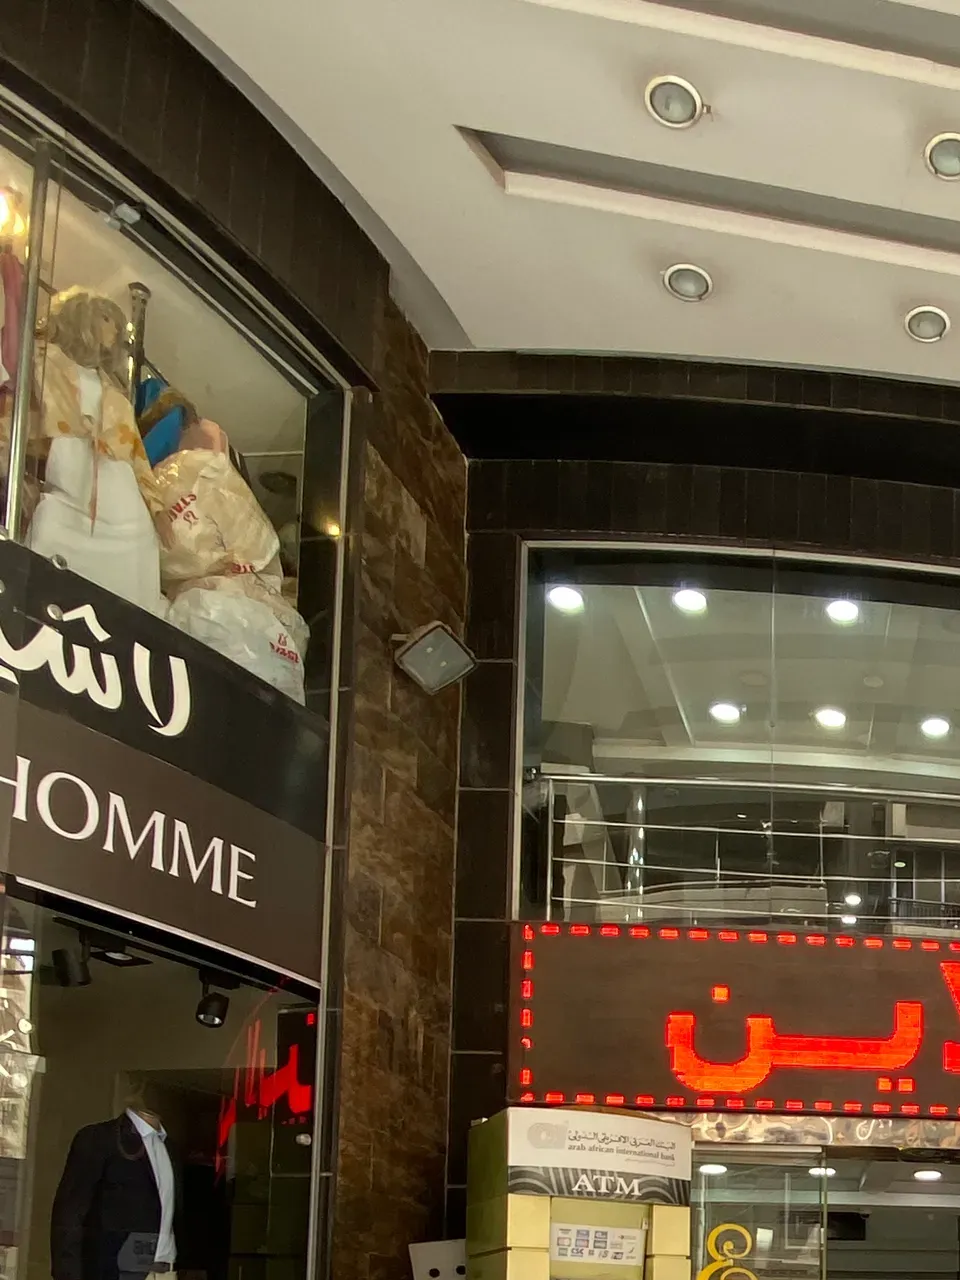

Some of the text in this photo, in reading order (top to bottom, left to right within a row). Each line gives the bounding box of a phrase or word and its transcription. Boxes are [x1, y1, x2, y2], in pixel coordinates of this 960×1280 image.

[0, 755, 259, 908] HOMME
[568, 1143, 675, 1161] arab african international bank
[572, 1173, 642, 1196] ATM
